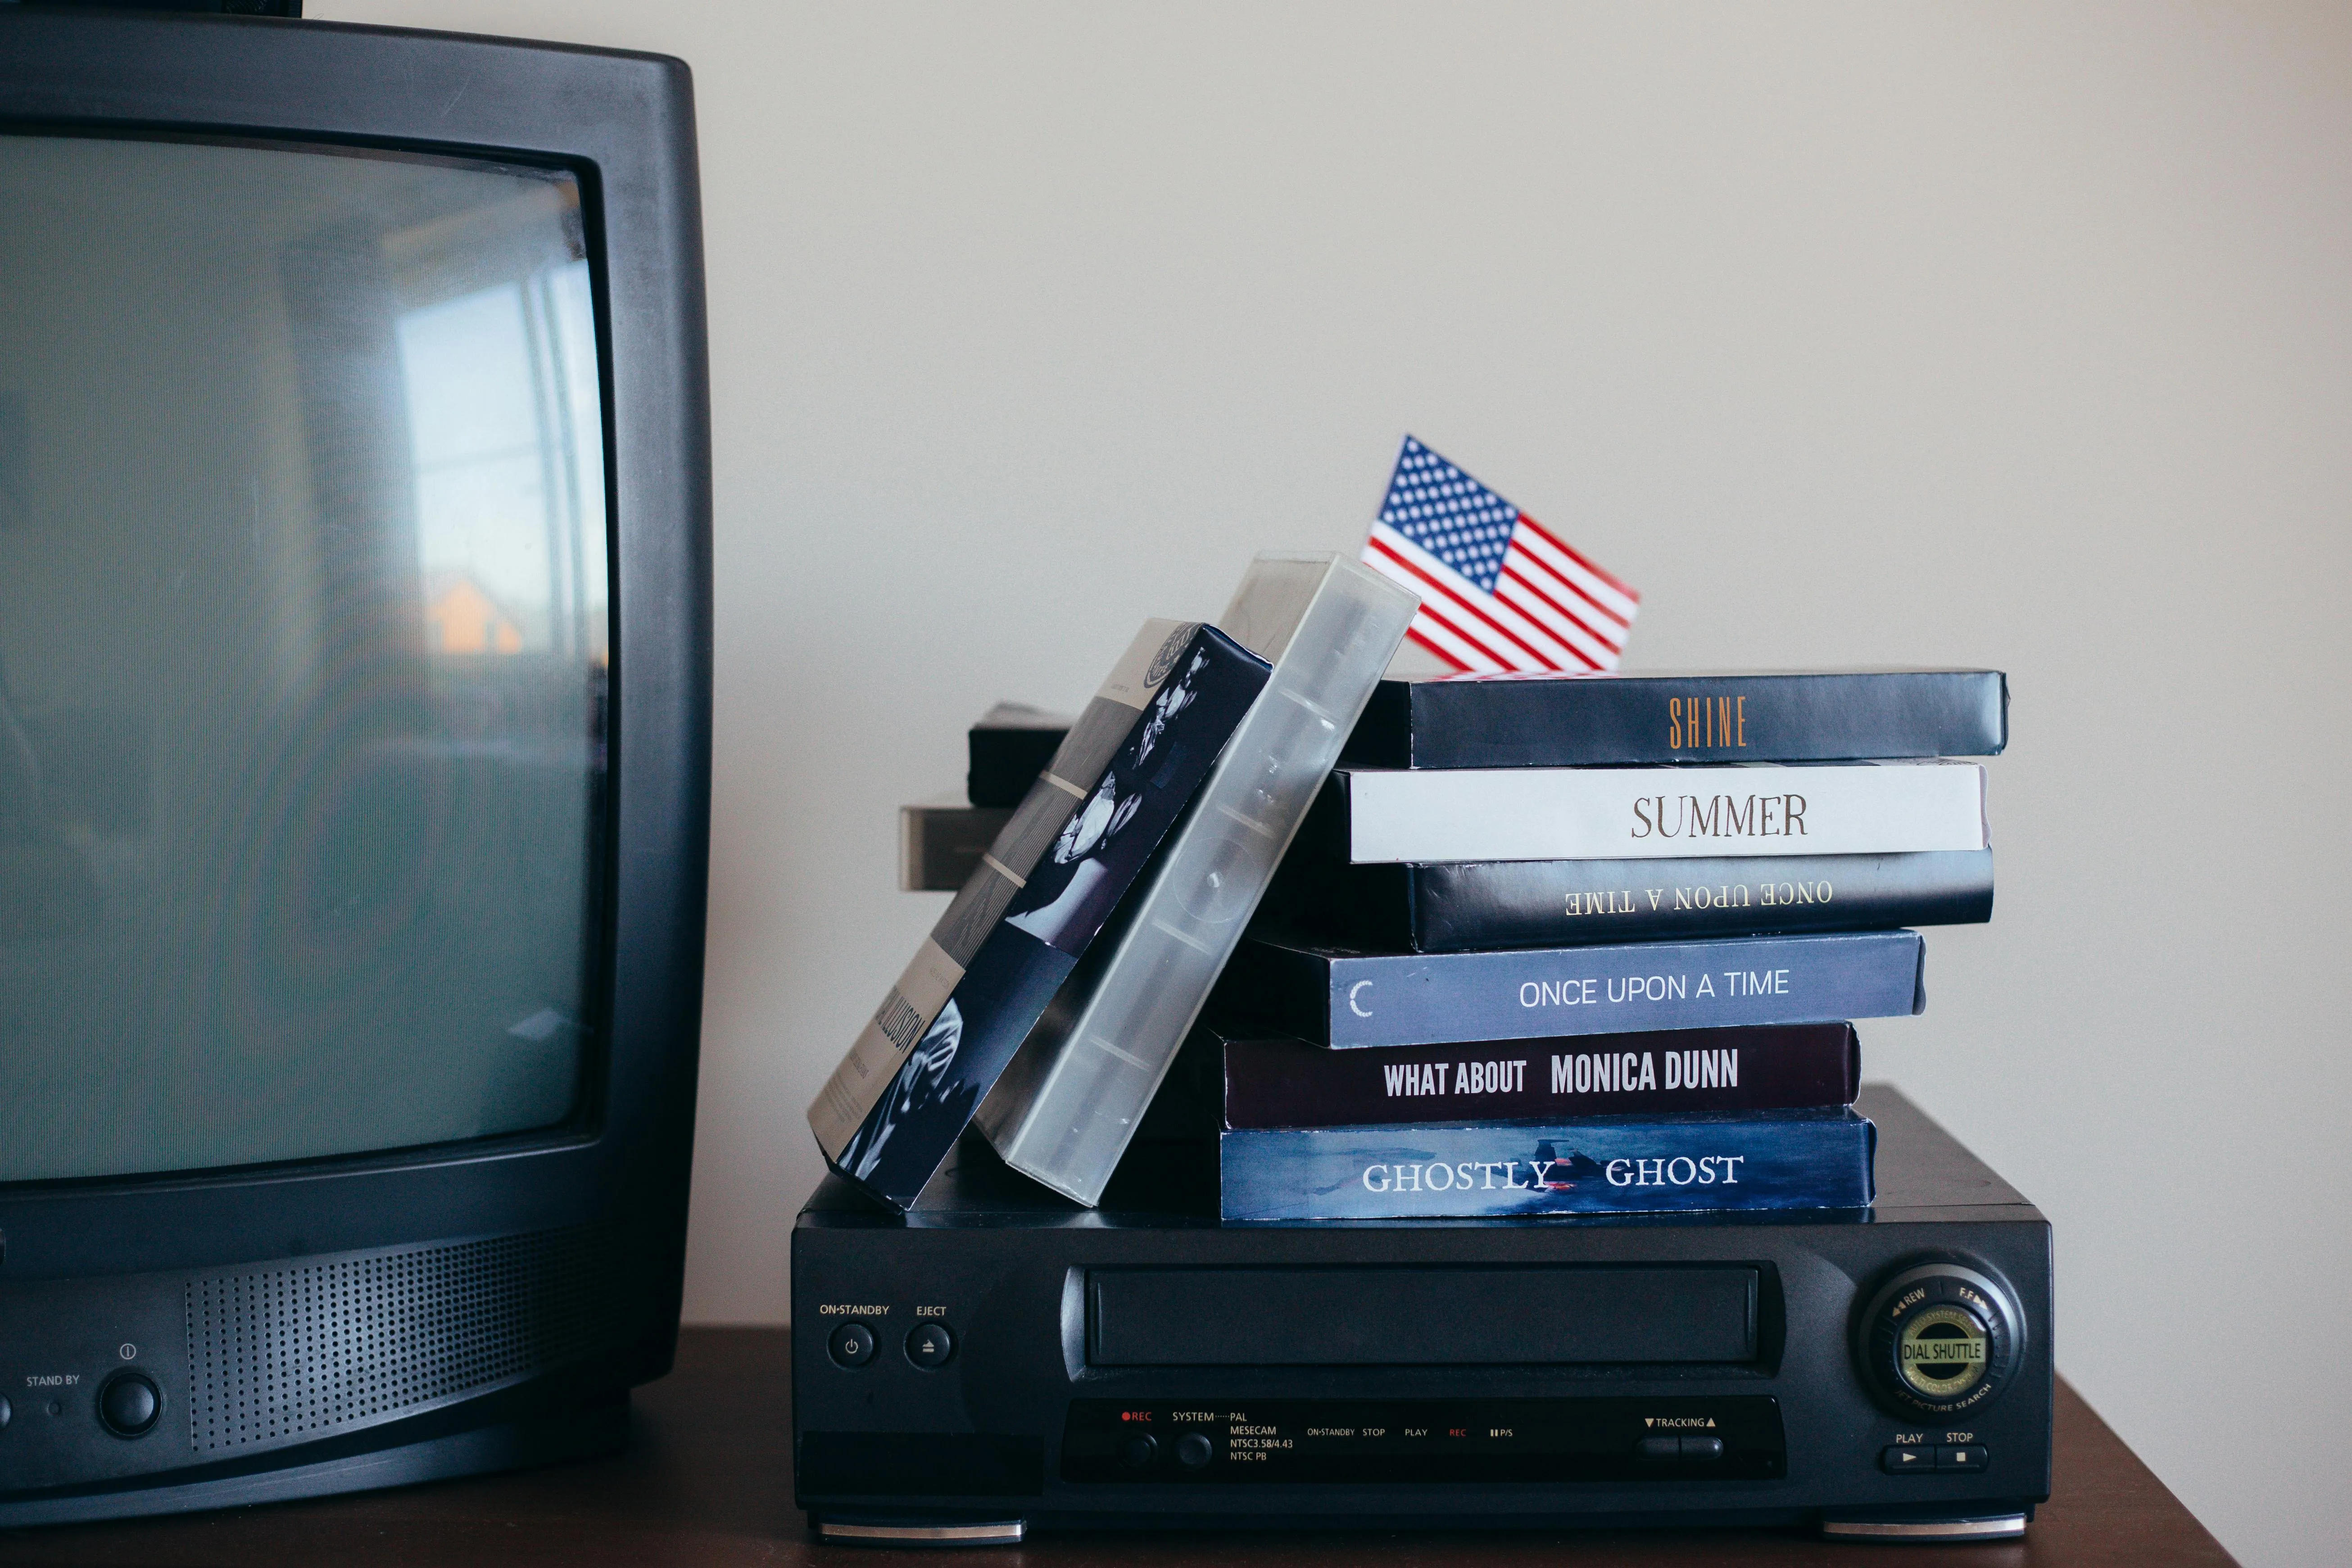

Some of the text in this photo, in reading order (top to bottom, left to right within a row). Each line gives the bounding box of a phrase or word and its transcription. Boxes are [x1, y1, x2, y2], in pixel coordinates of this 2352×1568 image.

[1669, 696, 1747, 749] SHINE
[1631, 794, 1808, 838] SUMMER
[1565, 881, 1833, 916] ONCE UPON A TIME
[1520, 969, 1790, 1007] ONCE UPON A TIME
[881, 996, 926, 1054] ILLUSION
[1384, 1049, 1738, 1097] WHAT ABOUT MONICA DUNN
[1363, 1156, 1744, 1193] GHOSTLY GHOST
[1903, 1287, 1926, 1305] REW
[917, 1306, 947, 1316] EJECT
[1904, 1343, 1981, 1360] DIAL SHUTTLE
[27, 1374, 80, 1387] STAND BY
[1926, 1382, 1953, 1392] COLOR
[1911, 1399, 1953, 1412] PICTURE
[1955, 1383, 1992, 1410] SEARCH
[1132, 1412, 1151, 1421] REC
[1173, 1412, 1247, 1422] SYSTEM PAL
[1656, 1418, 1704, 1427] TRACKING
[1230, 1426, 1276, 1435] MESECAM
[1405, 1428, 1428, 1437] PLAY
[1500, 1429, 1513, 1437] P/S
[1896, 1433, 1923, 1443] PLAY
[1947, 1432, 1973, 1442] STOP
[1230, 1451, 1267, 1461] NTSC PB
